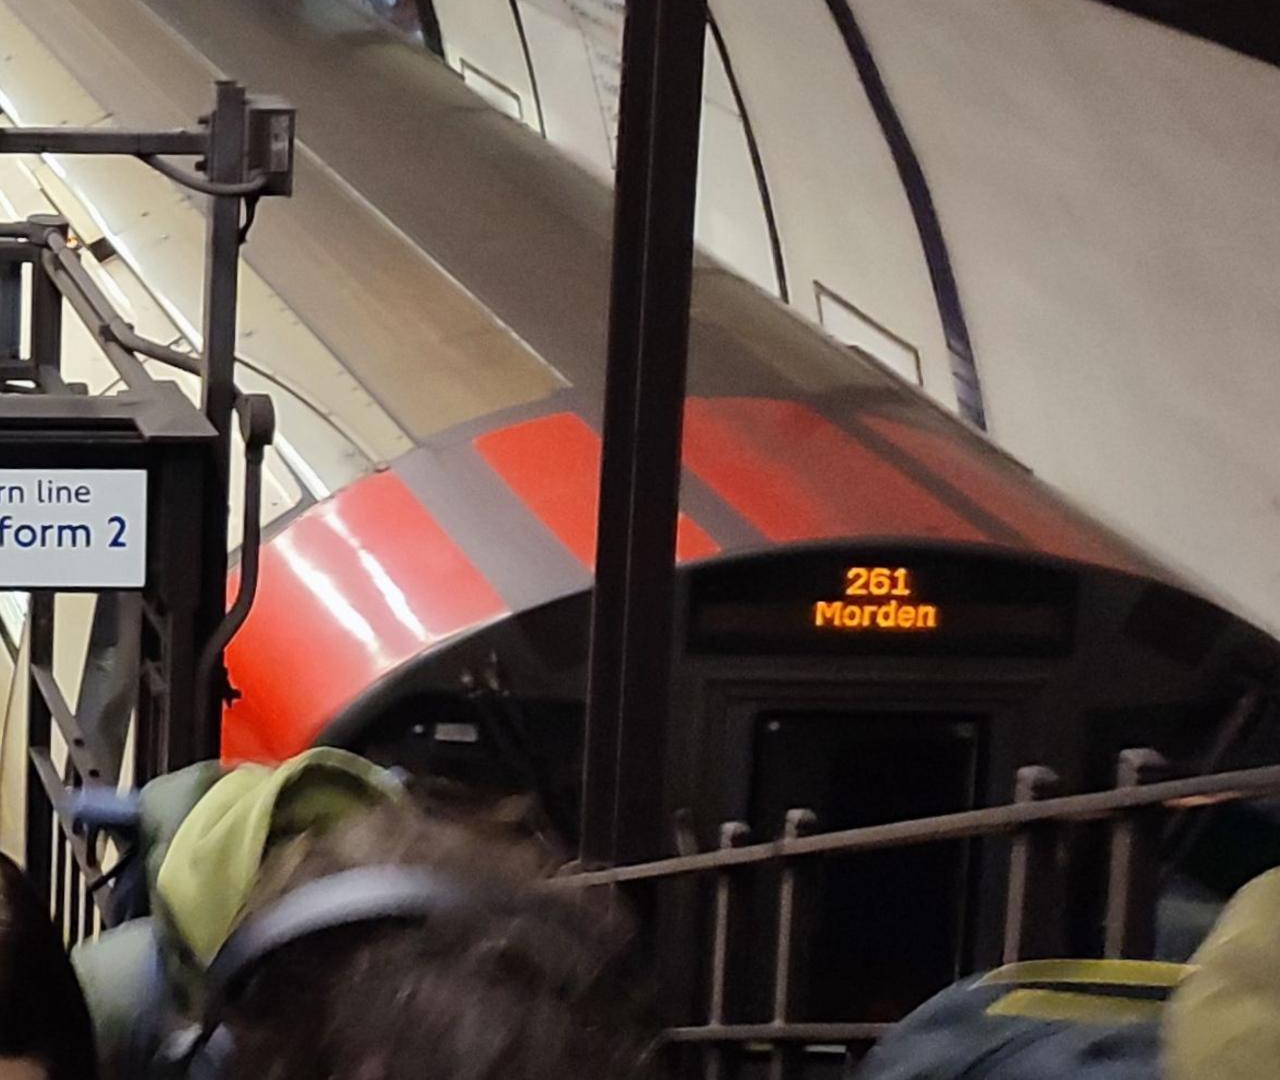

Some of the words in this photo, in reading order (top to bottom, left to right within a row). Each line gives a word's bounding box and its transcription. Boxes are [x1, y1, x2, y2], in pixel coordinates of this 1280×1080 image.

[37, 479, 92, 504] line
[107, 516, 128, 548] 2
[845, 567, 911, 596] 261
[814, 600, 937, 629] Morden
